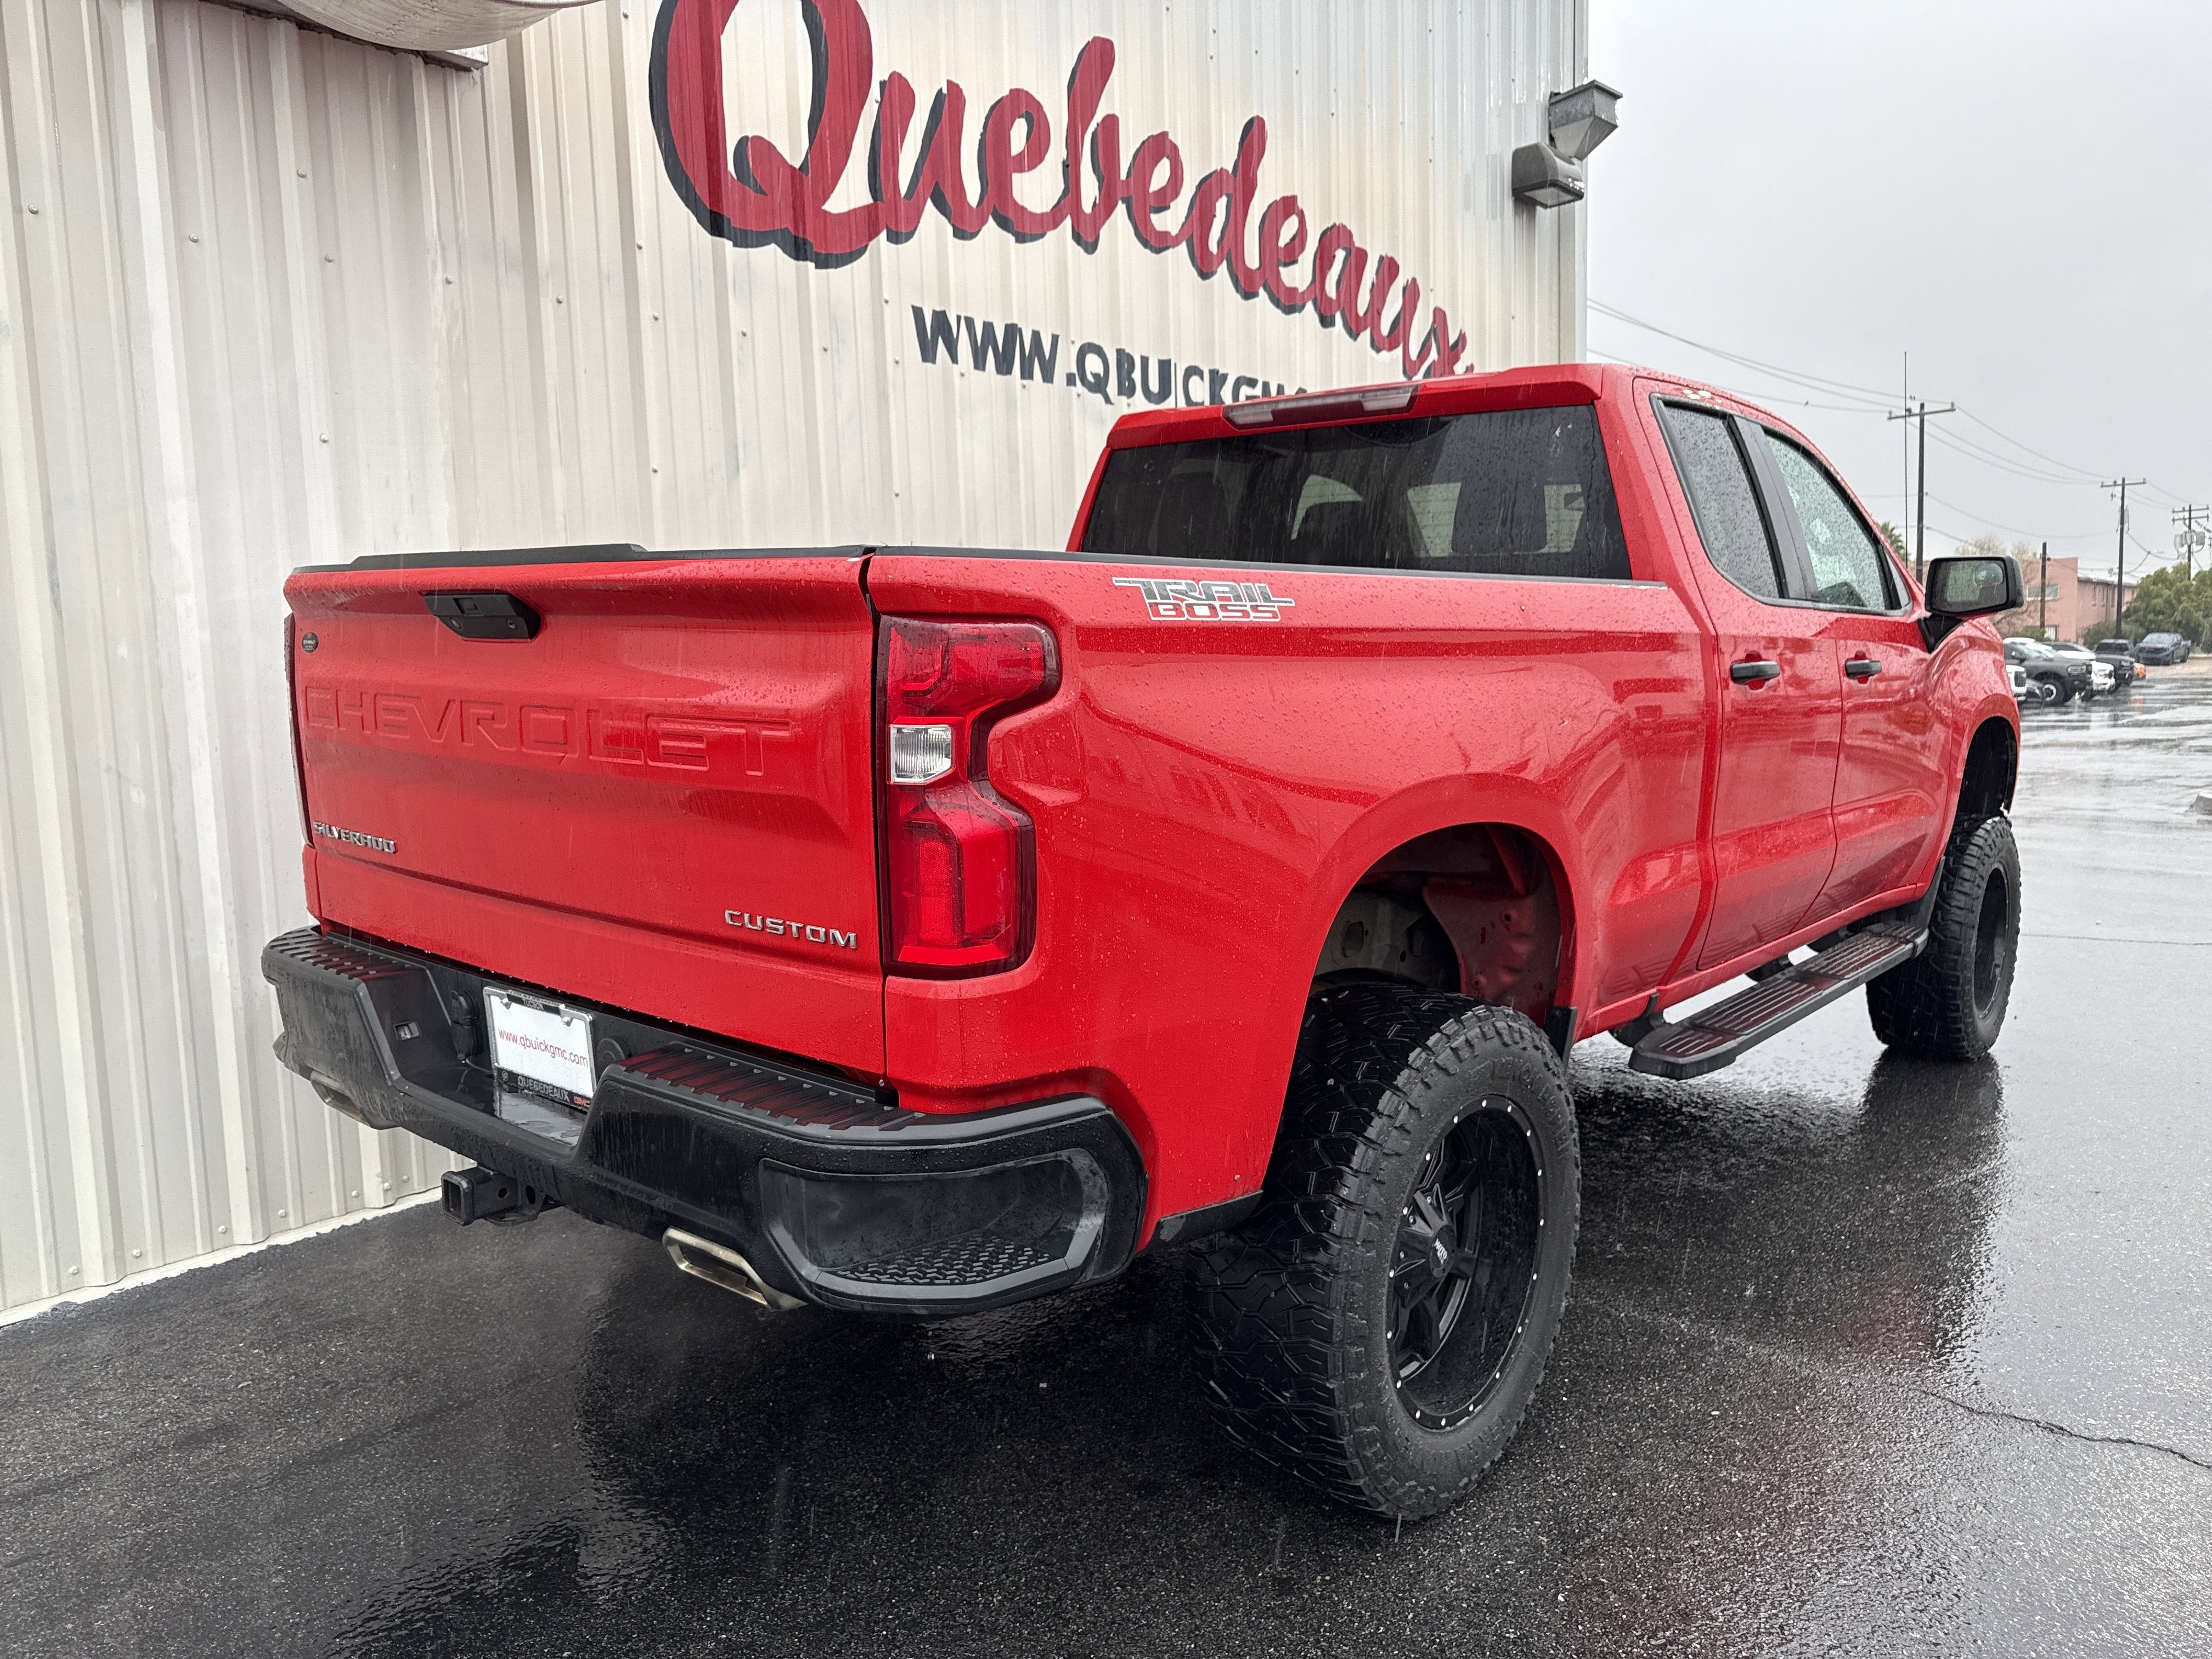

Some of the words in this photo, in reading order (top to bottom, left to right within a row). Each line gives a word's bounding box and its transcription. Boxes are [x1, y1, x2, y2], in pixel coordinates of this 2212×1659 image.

[1112, 577, 1295, 606] TRAIL
[1148, 602, 1281, 622] BOSS
[304, 686, 795, 776] CHEVROLET
[313, 821, 397, 854] SILVERADO
[725, 909, 857, 949] CUSTOM
[522, 998, 544, 1011] TUCSON
[498, 1028, 589, 1068] www.qbuickgmc.com
[517, 1075, 570, 1102] QUEBEDEAUX
[573, 1096, 591, 1107] GMC
